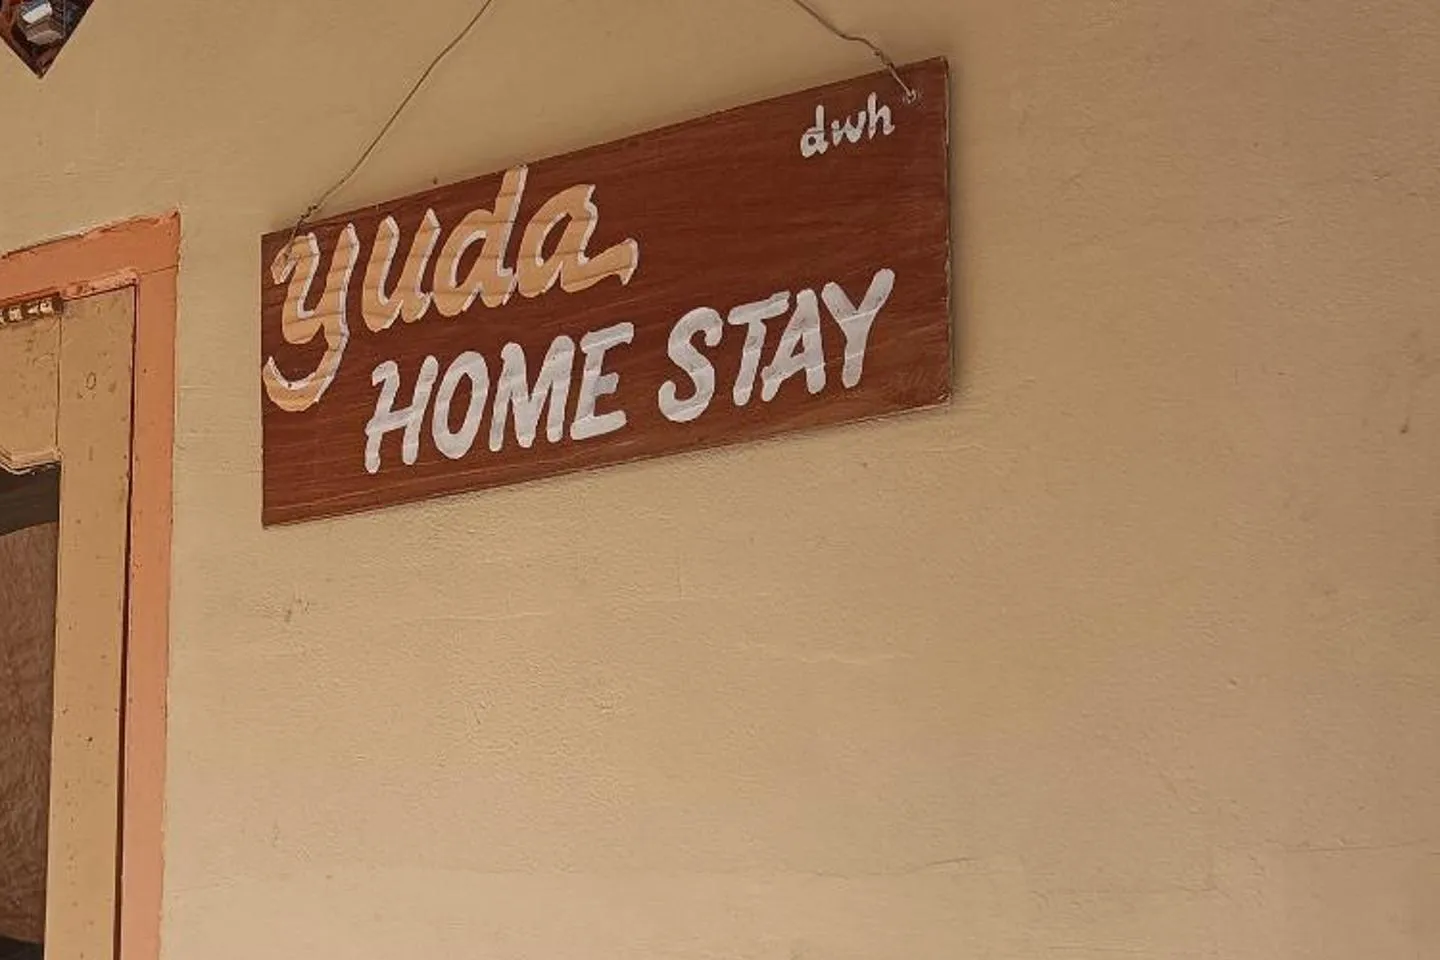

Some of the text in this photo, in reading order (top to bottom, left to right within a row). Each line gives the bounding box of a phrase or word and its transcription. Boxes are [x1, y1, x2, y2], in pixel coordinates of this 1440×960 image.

[801, 94, 895, 157] dwh
[365, 269, 895, 473] HOME STAY
